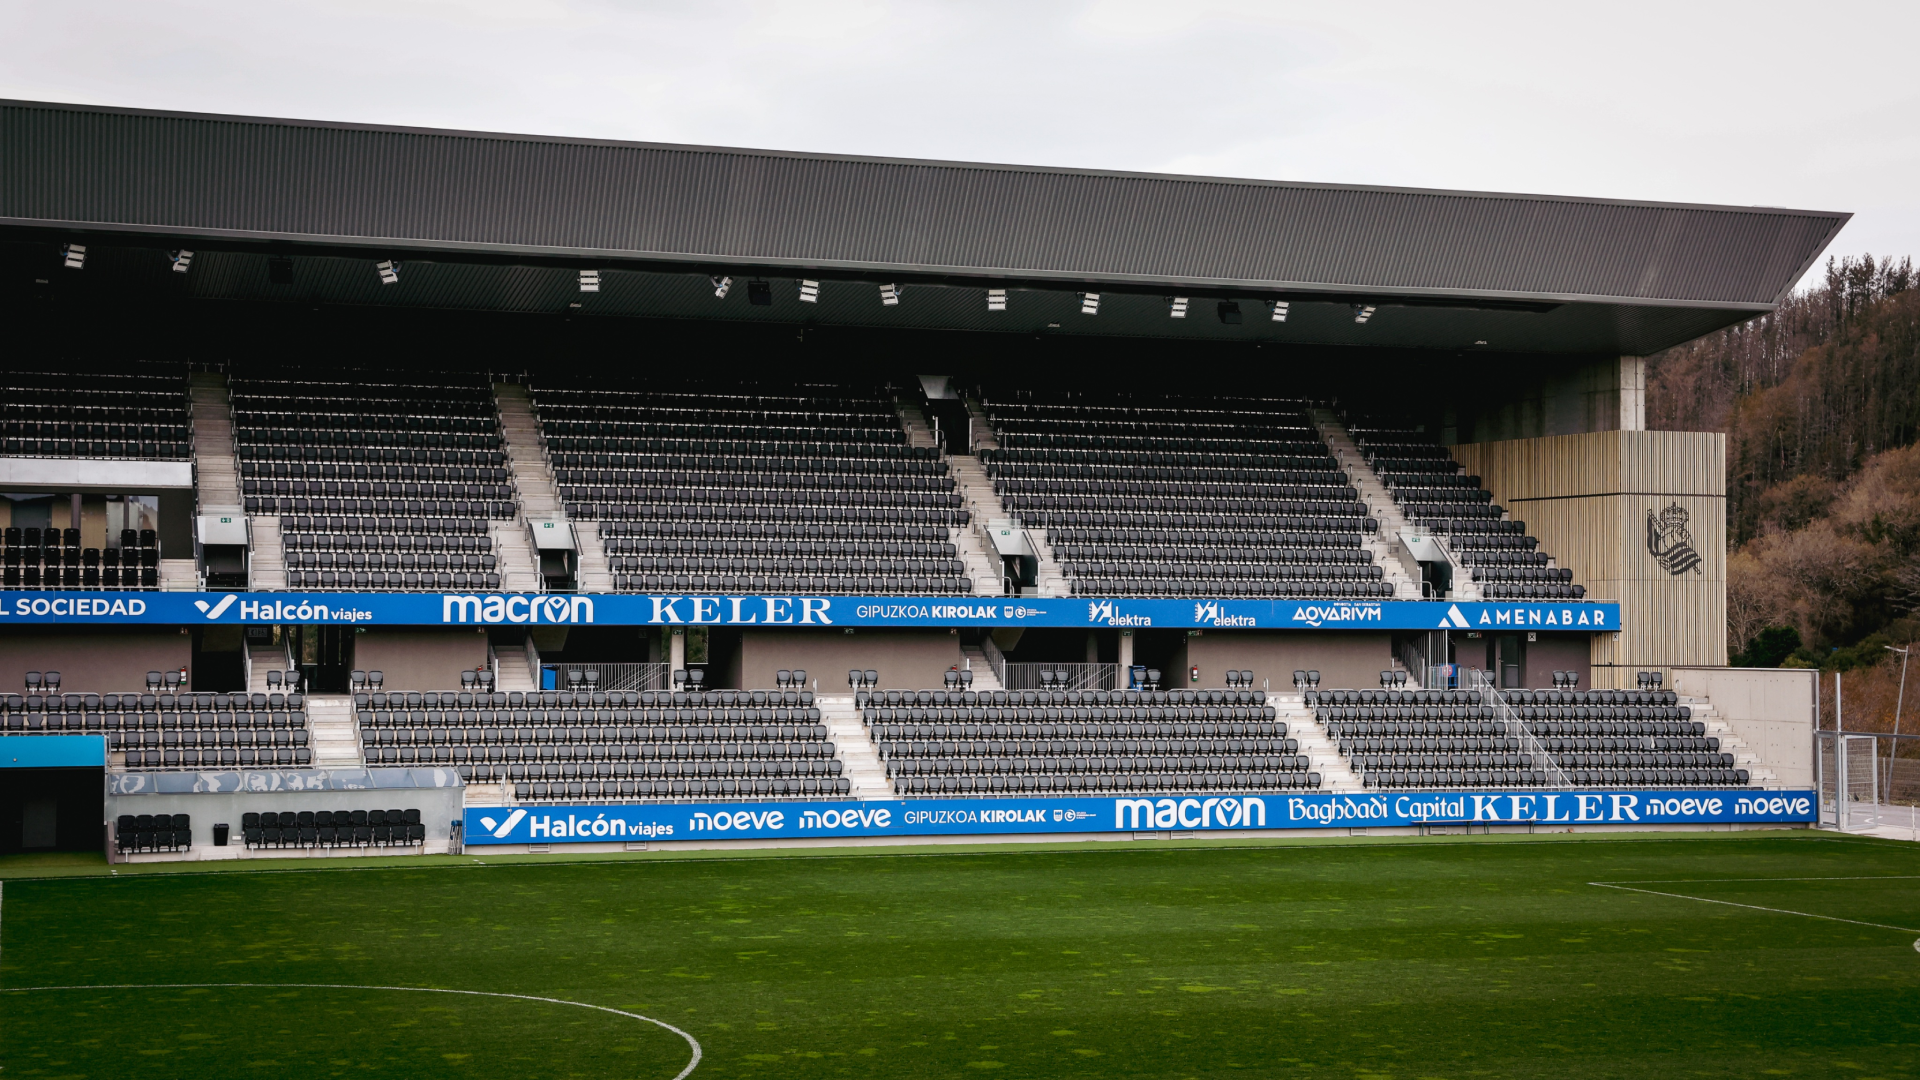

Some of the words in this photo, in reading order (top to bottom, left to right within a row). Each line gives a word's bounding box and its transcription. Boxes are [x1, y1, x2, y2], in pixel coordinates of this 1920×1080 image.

[16, 598, 147, 616] SOCIEDAD
[240, 600, 329, 621] Halcón
[331, 608, 373, 623] viajes
[443, 596, 594, 623] macron
[648, 597, 833, 625] KELER
[856, 605, 929, 619] GIPUZKOA
[931, 605, 997, 619] KIROLAK
[1107, 606, 1152, 626] elektra
[1213, 606, 1256, 627] elektra
[1479, 608, 1605, 626] AMENABAR
[904, 810, 977, 824] GIPUZKOA
[980, 809, 1047, 823] KIROLAK
[1115, 797, 1266, 829] macron
[1288, 796, 1389, 825] Baghdadi
[1395, 796, 1465, 822] Capital
[1470, 795, 1640, 822] KELER
[1646, 797, 1723, 816] moeve
[1734, 797, 1811, 816] moeve
[530, 813, 626, 838] Halcón
[628, 822, 674, 838] viajes
[689, 810, 785, 832] moeve
[799, 808, 892, 829] moeve
